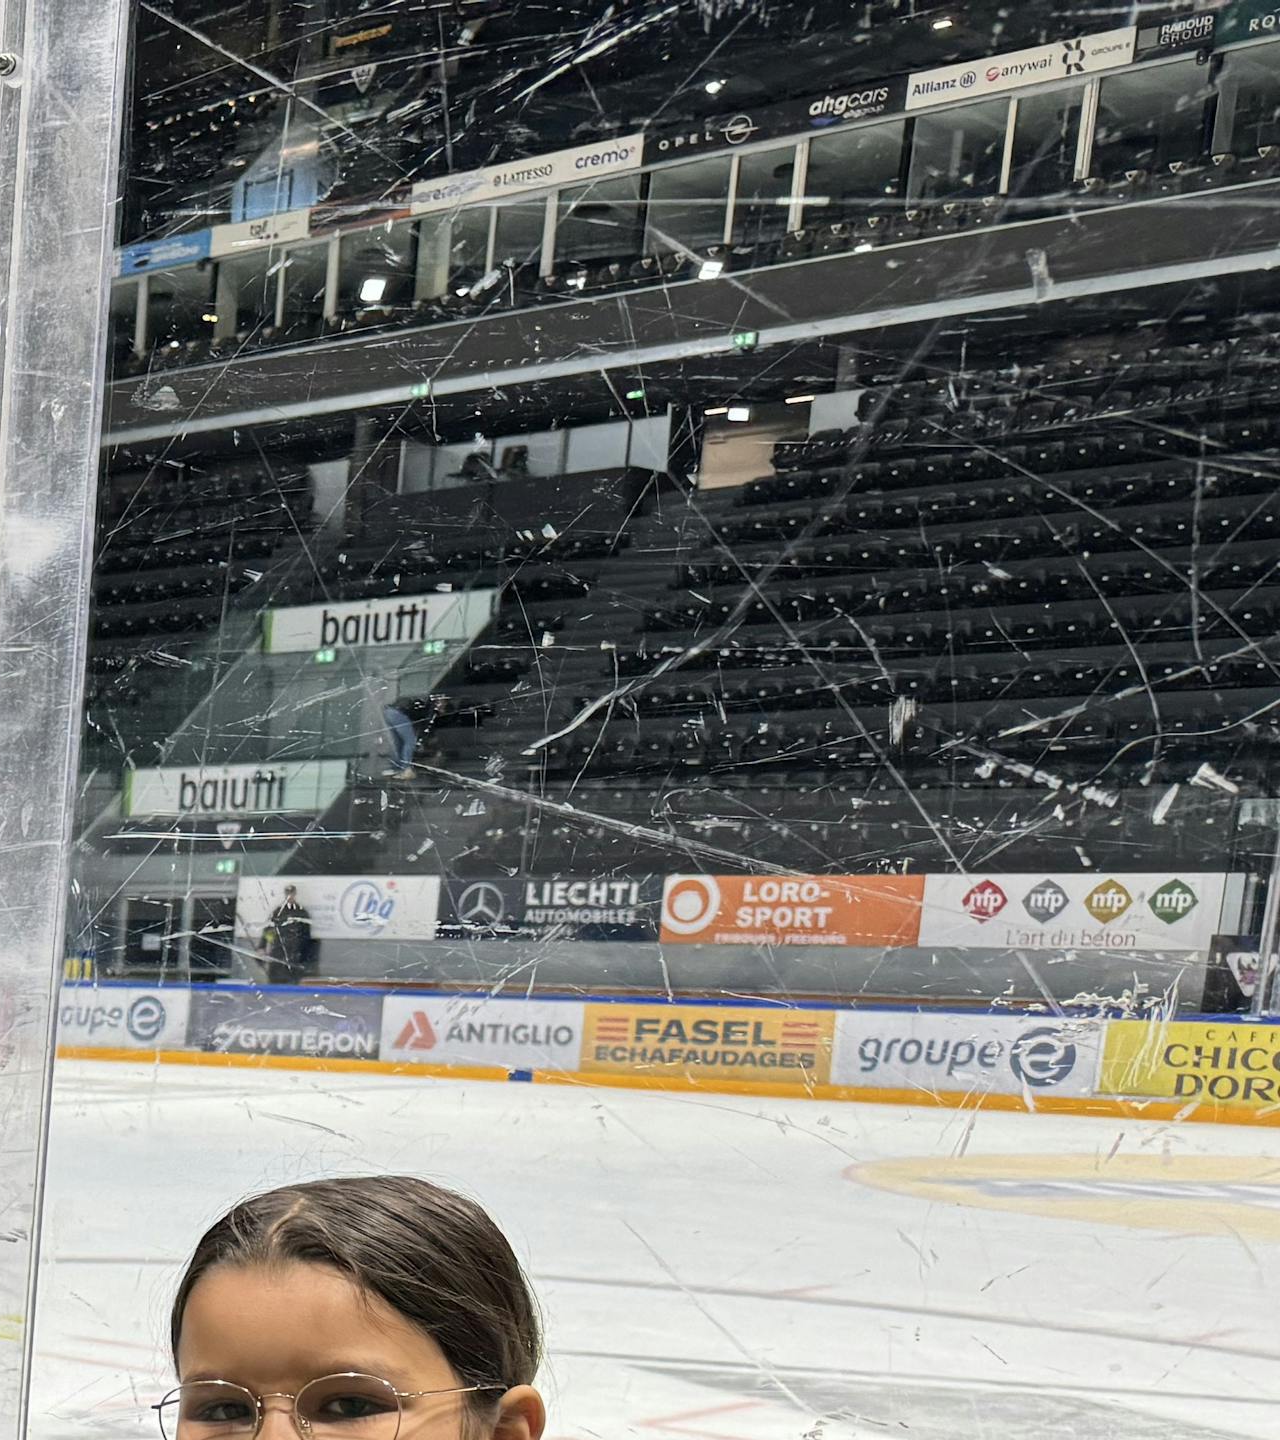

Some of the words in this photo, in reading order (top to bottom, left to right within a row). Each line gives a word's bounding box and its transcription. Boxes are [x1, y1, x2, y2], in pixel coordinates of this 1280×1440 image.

[1249, 13, 1280, 32] RO
[1160, 25, 1213, 45] GROUP
[912, 77, 957, 96] Allianz
[808, 86, 889, 116] ahgcars
[658, 131, 713, 151] OPEL
[575, 148, 630, 170] cremo
[525, 880, 639, 906] LIECHTI
[523, 907, 638, 924] AUTOMOBILES
[736, 906, 833, 928] SPORT
[1051, 929, 1075, 947] du
[60, 1004, 123, 1035] oupe
[445, 1021, 574, 1047] ANTIGLIO
[634, 1018, 777, 1048] FASEL
[857, 1034, 1005, 1074] groupe
[1174, 1073, 1280, 1101] D'OR
